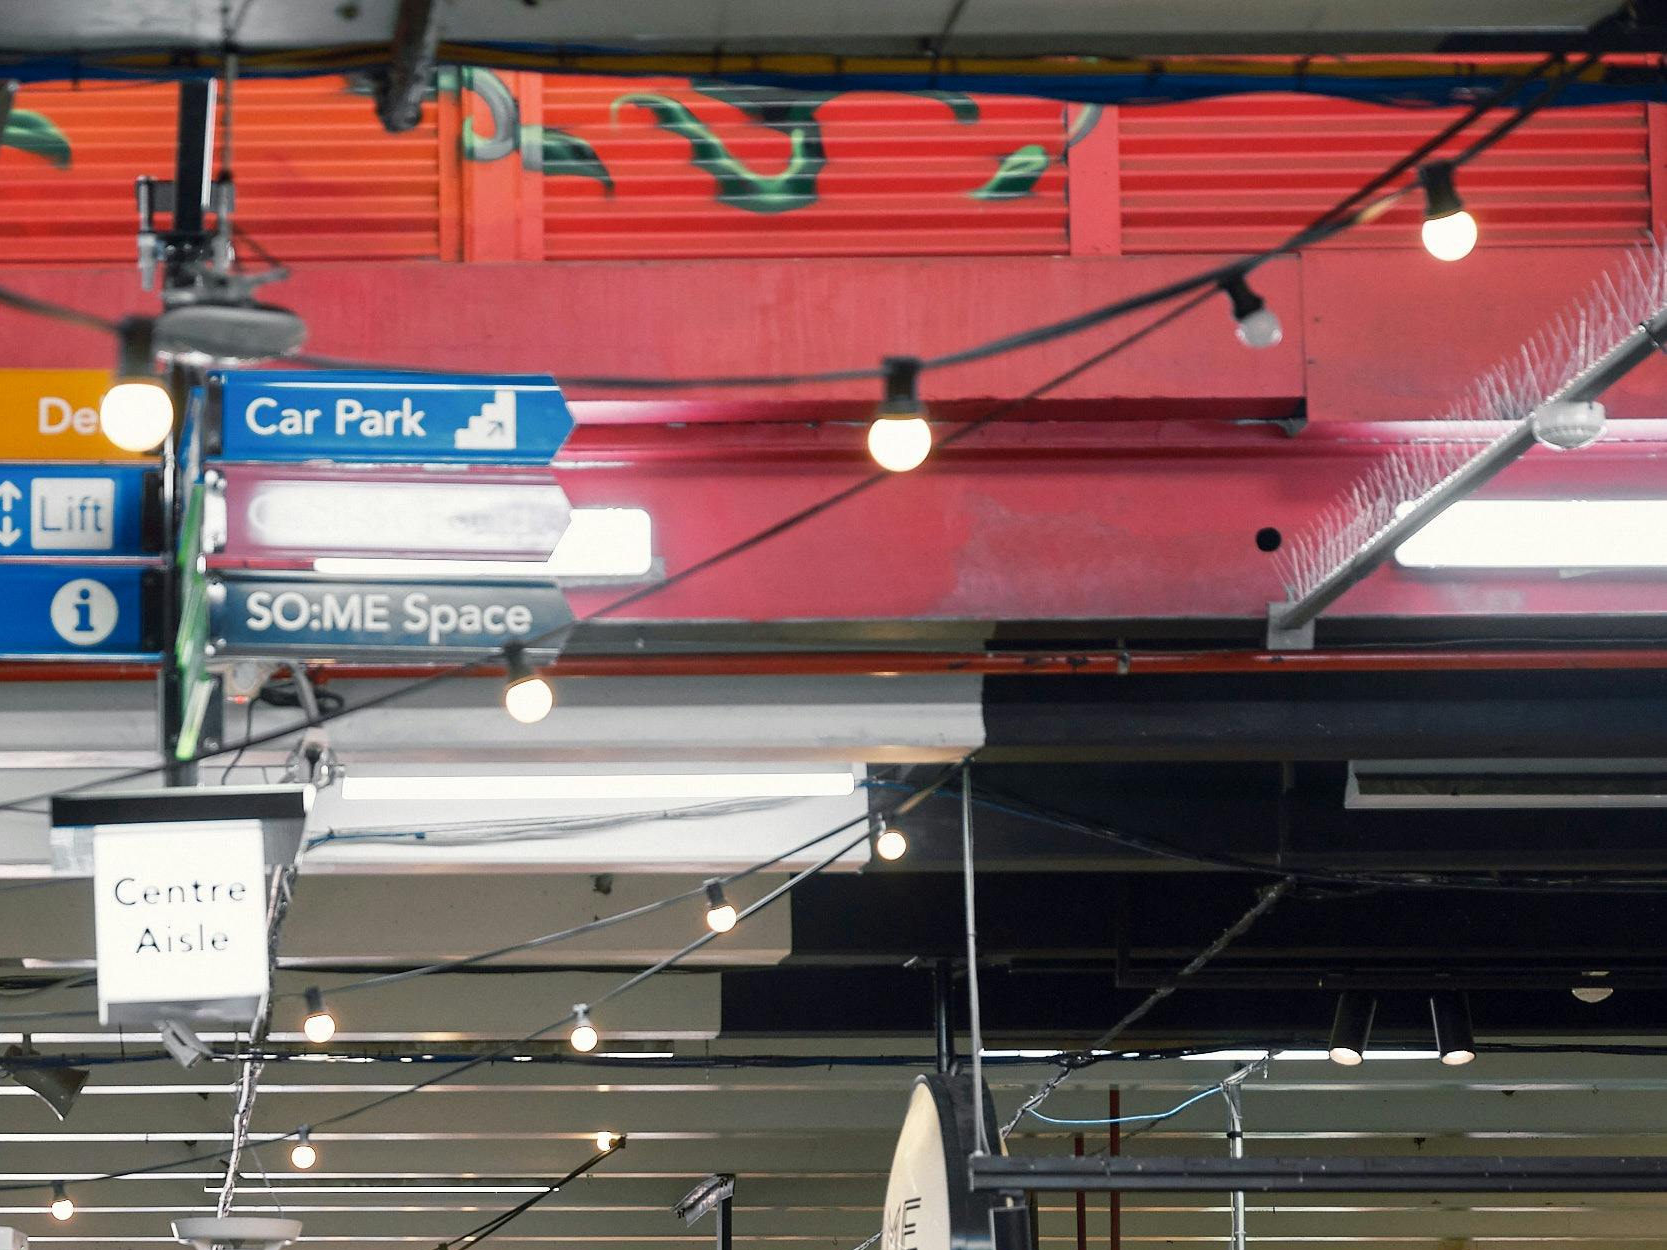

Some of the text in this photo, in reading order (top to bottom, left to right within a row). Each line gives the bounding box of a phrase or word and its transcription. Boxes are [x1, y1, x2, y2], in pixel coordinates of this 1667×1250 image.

[38, 396, 103, 435] De
[245, 397, 426, 438] Car Park
[40, 495, 103, 532] Lift
[245, 591, 533, 645] SO:ME Space
[113, 876, 246, 907] Centre
[135, 924, 229, 954] Aisle
